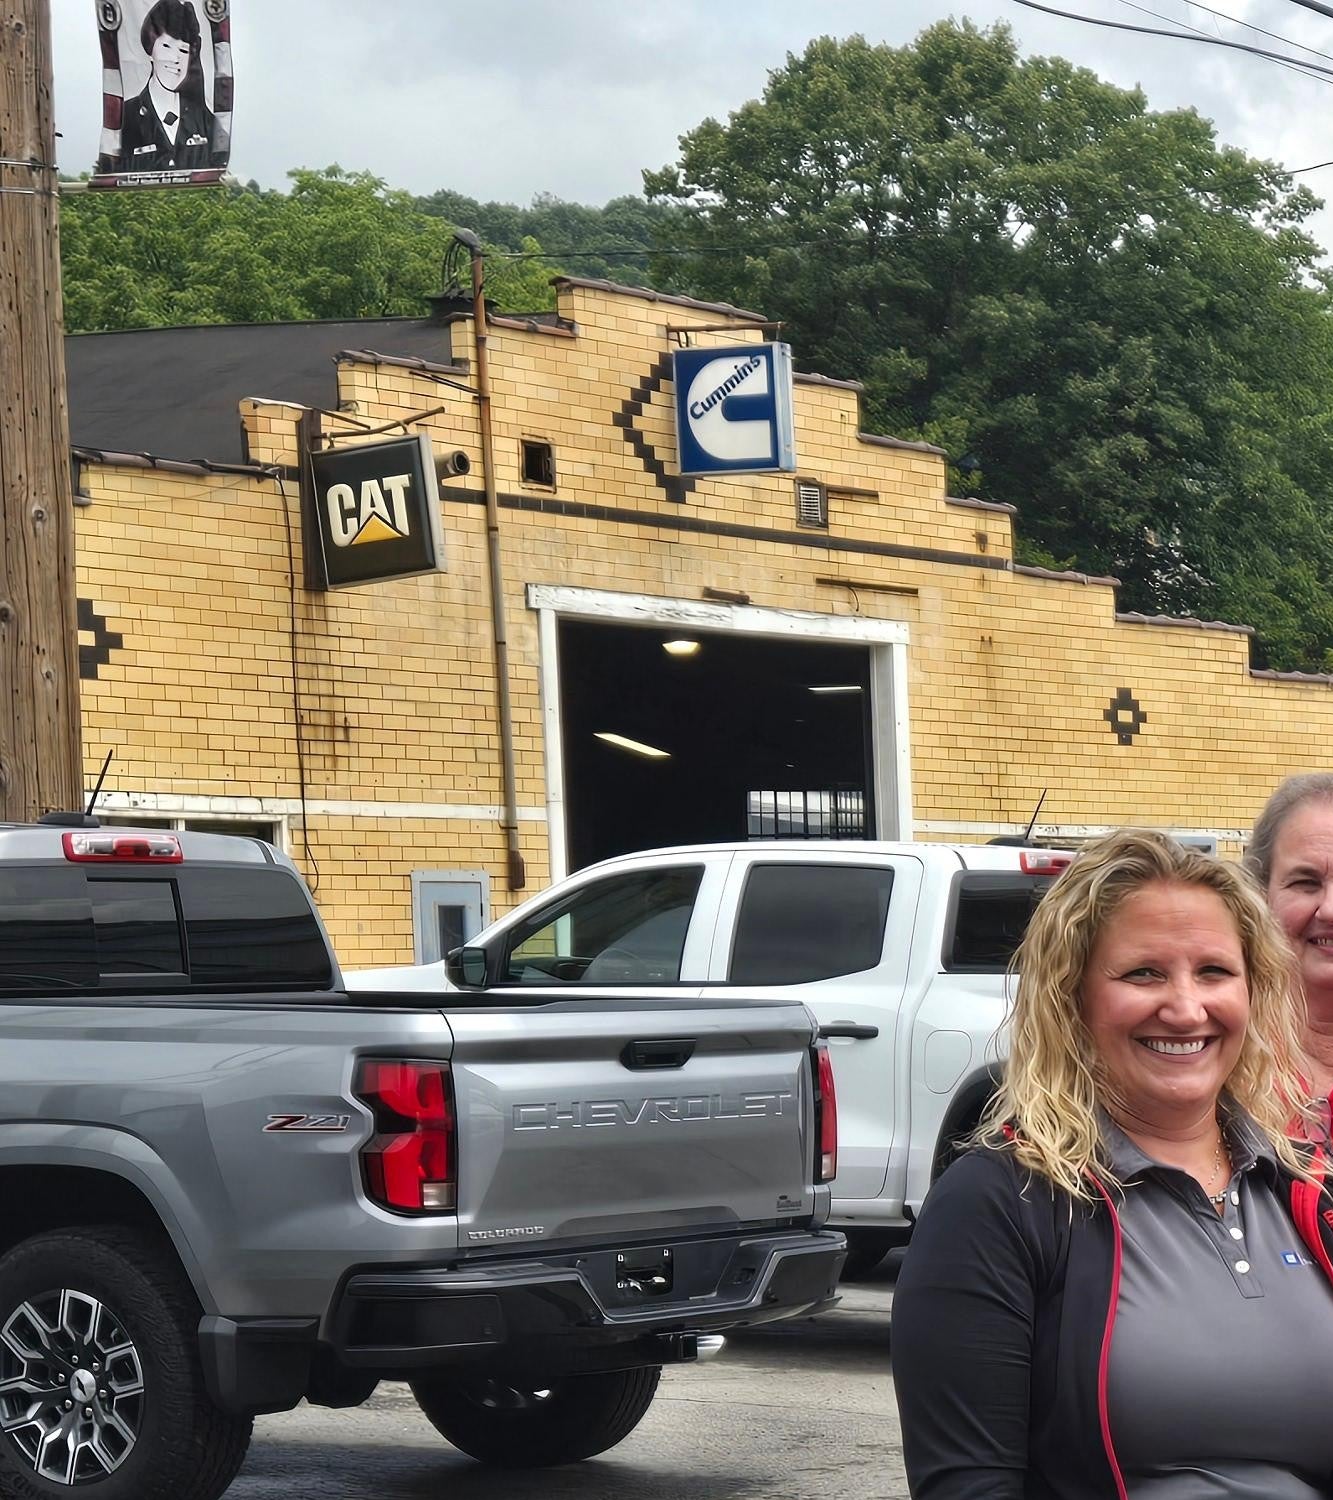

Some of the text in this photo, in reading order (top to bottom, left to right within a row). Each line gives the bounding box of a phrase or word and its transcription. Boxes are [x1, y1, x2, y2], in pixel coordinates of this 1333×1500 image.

[690, 354, 761, 420] Cummins
[327, 473, 411, 547] CAT
[512, 1090, 791, 1131] CHEVROLET
